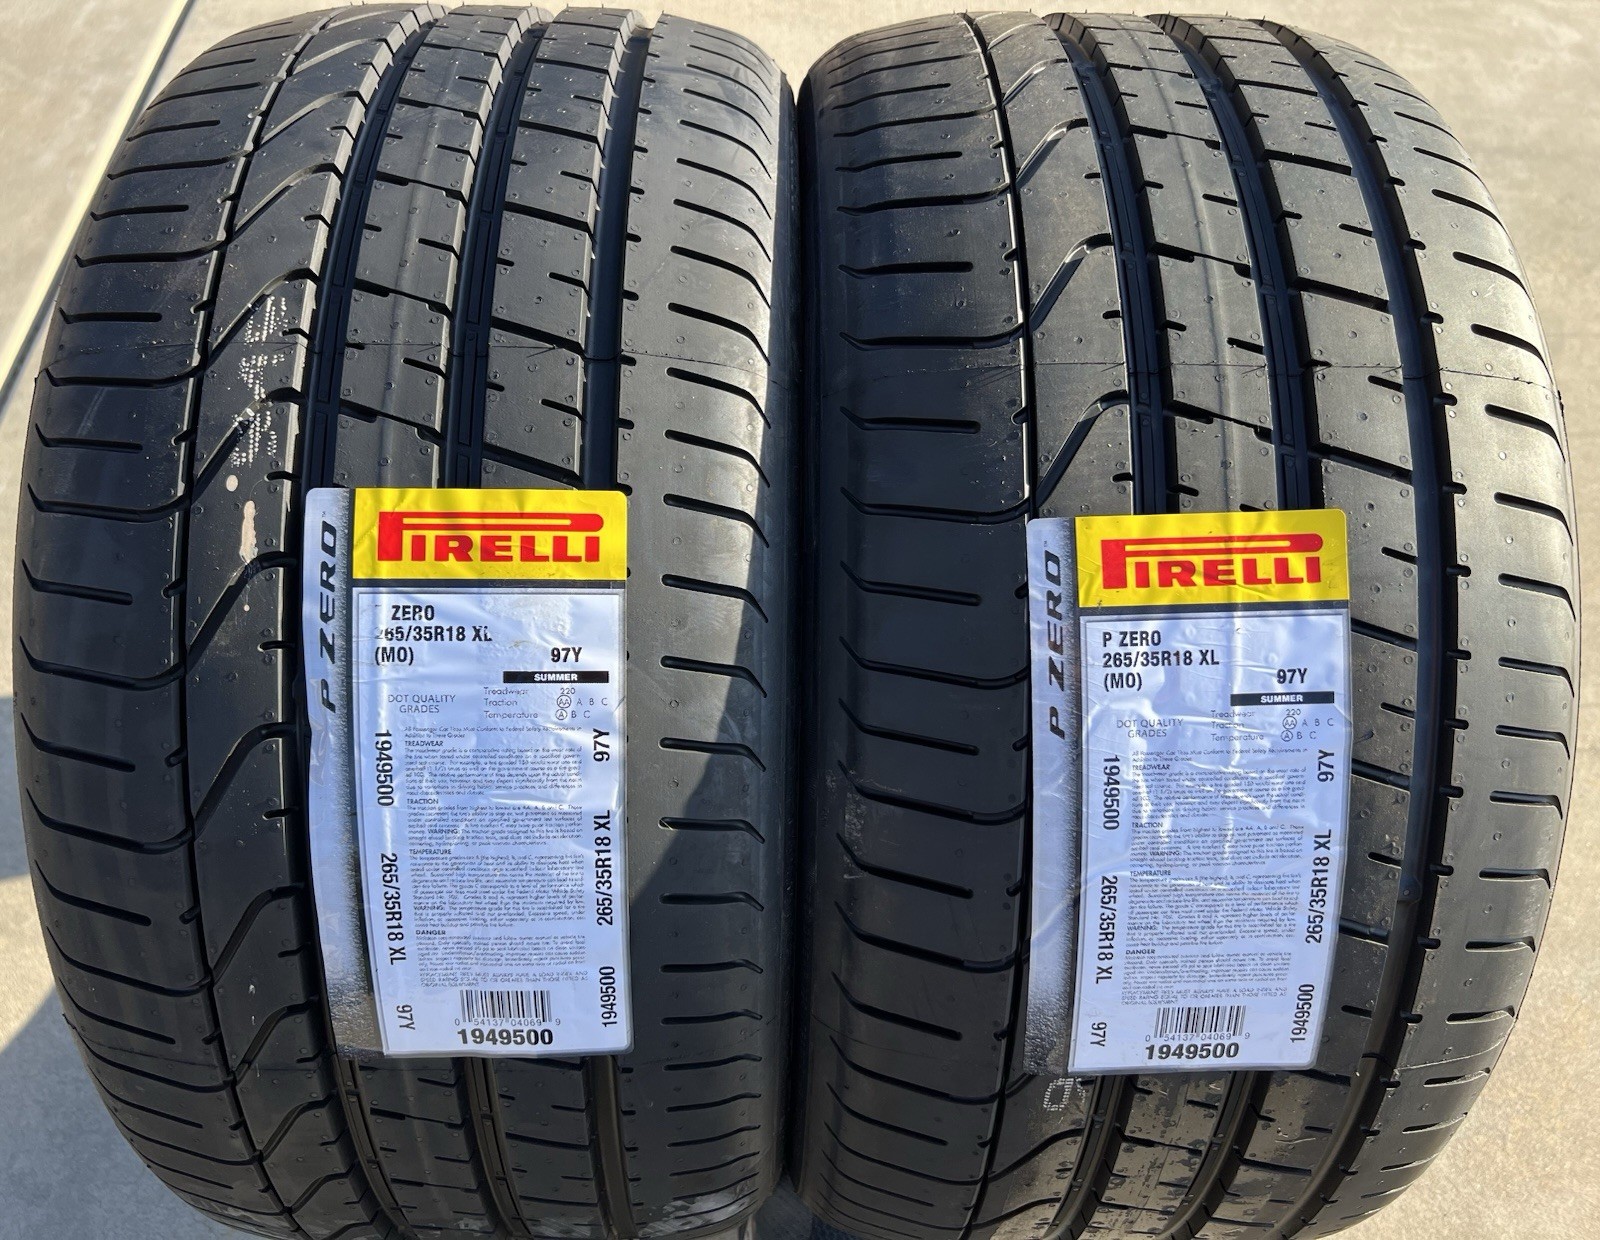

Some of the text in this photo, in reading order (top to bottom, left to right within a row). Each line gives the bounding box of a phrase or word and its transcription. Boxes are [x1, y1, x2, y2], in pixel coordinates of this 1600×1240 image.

[377, 511, 604, 563] PIRELLI
[1100, 533, 1324, 590] PIRELLI
[320, 520, 337, 713] P ZERO
[391, 605, 435, 621] ZERO
[472, 625, 493, 641] XL
[1102, 630, 1161, 648] P ZERO
[1045, 550, 1065, 740] P ZERO
[375, 646, 414, 666] (MO)
[551, 647, 582, 662] 97Y
[1102, 649, 1220, 668] 265/35R18 XL
[534, 673, 578, 681] SUMMER
[1104, 671, 1143, 692] (MO)
[1276, 667, 1308, 684] 97Y
[387, 694, 456, 704] DOT QUALITY
[484, 698, 518, 706] Traction
[577, 698, 583, 706] A
[589, 698, 595, 706] B
[601, 698, 608, 706] C
[1260, 694, 1304, 703] SUMMER
[399, 704, 440, 714] GRADES
[484, 710, 539, 719] Temperature
[583, 710, 591, 718] C
[1286, 707, 1301, 716] 220
[1116, 717, 1184, 729] DOT QUALITY
[1327, 718, 1334, 726] C
[1127, 728, 1168, 739] GRADES
[1309, 731, 1317, 739] C
[592, 728, 610, 762] 97Y
[374, 729, 395, 807] 1949500
[1317, 749, 1335, 782] 97Y
[1102, 754, 1120, 830] 1949500
[593, 809, 613, 926] 265/35R18 XL
[1305, 829, 1332, 944] 265/35R18 XL
[380, 852, 406, 966] 265/35R18 XL
[1095, 875, 1118, 984] 265/35R18 XL
[599, 966, 618, 1028] 1949500
[396, 1004, 416, 1031] 97Y
[473, 1018, 504, 1026] 54137
[511, 1018, 542, 1026] 04069
[555, 1018, 561, 1026] 9
[1290, 983, 1315, 1044] 1949500
[457, 1028, 554, 1045] 1949500
[1090, 1021, 1108, 1047] 97Y
[1163, 1034, 1195, 1042] 54137
[1200, 1032, 1232, 1041] 04069
[1244, 1032, 1250, 1040] 9
[1145, 1043, 1240, 1060] 1949500
